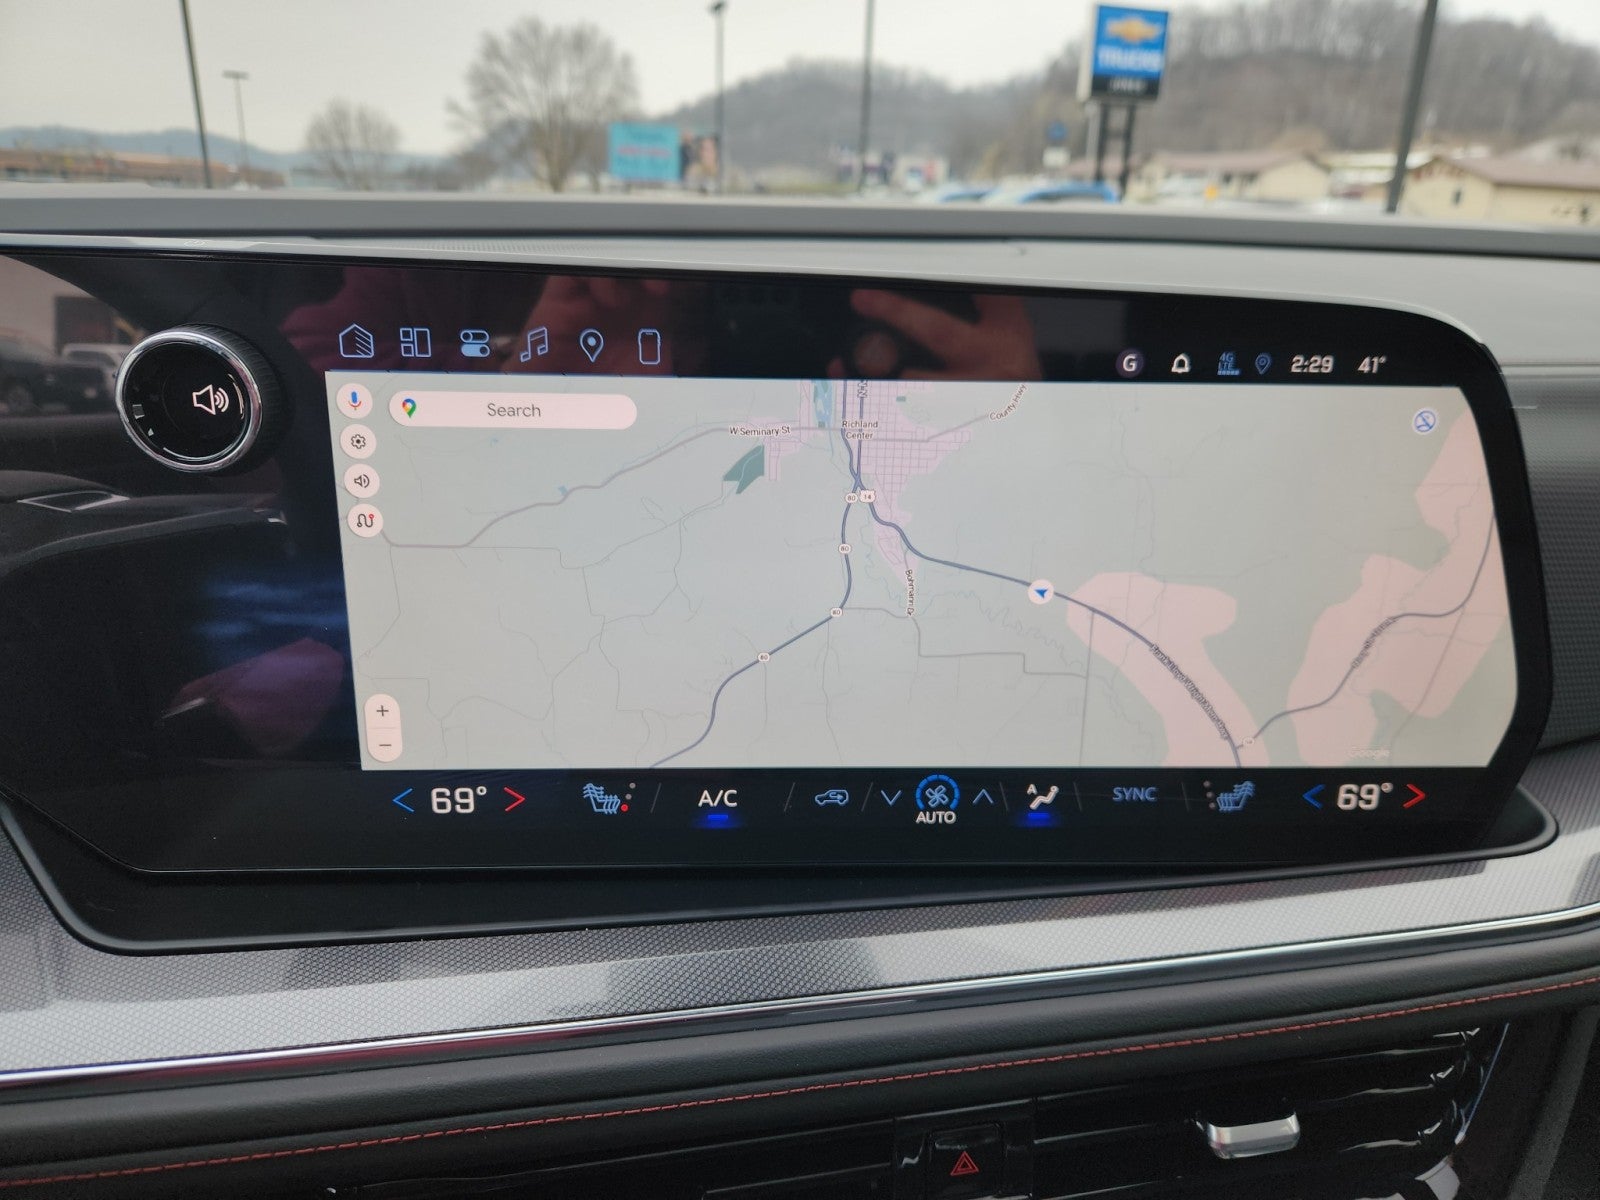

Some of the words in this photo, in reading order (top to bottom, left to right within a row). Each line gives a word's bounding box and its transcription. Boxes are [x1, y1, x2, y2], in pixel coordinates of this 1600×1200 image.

[1122, 353, 1136, 372] G
[1219, 352, 1234, 361] 4G
[1291, 355, 1334, 373] 2:29
[1218, 362, 1235, 371] LTE
[990, 403, 1016, 420] County
[1012, 384, 1027, 402] Hwy
[487, 403, 541, 418] Search
[729, 427, 738, 435] W
[740, 427, 779, 436] Seminary
[781, 426, 791, 434] St
[842, 420, 878, 429] Richland
[846, 432, 873, 440] Center
[907, 607, 914, 616] Dr
[1027, 784, 1037, 795] A
[1112, 786, 1158, 803] SYNC
[1337, 782, 1394, 811] 69°
[430, 786, 488, 814] 69°
[698, 789, 738, 807] A/C
[916, 810, 957, 825] AUTO
